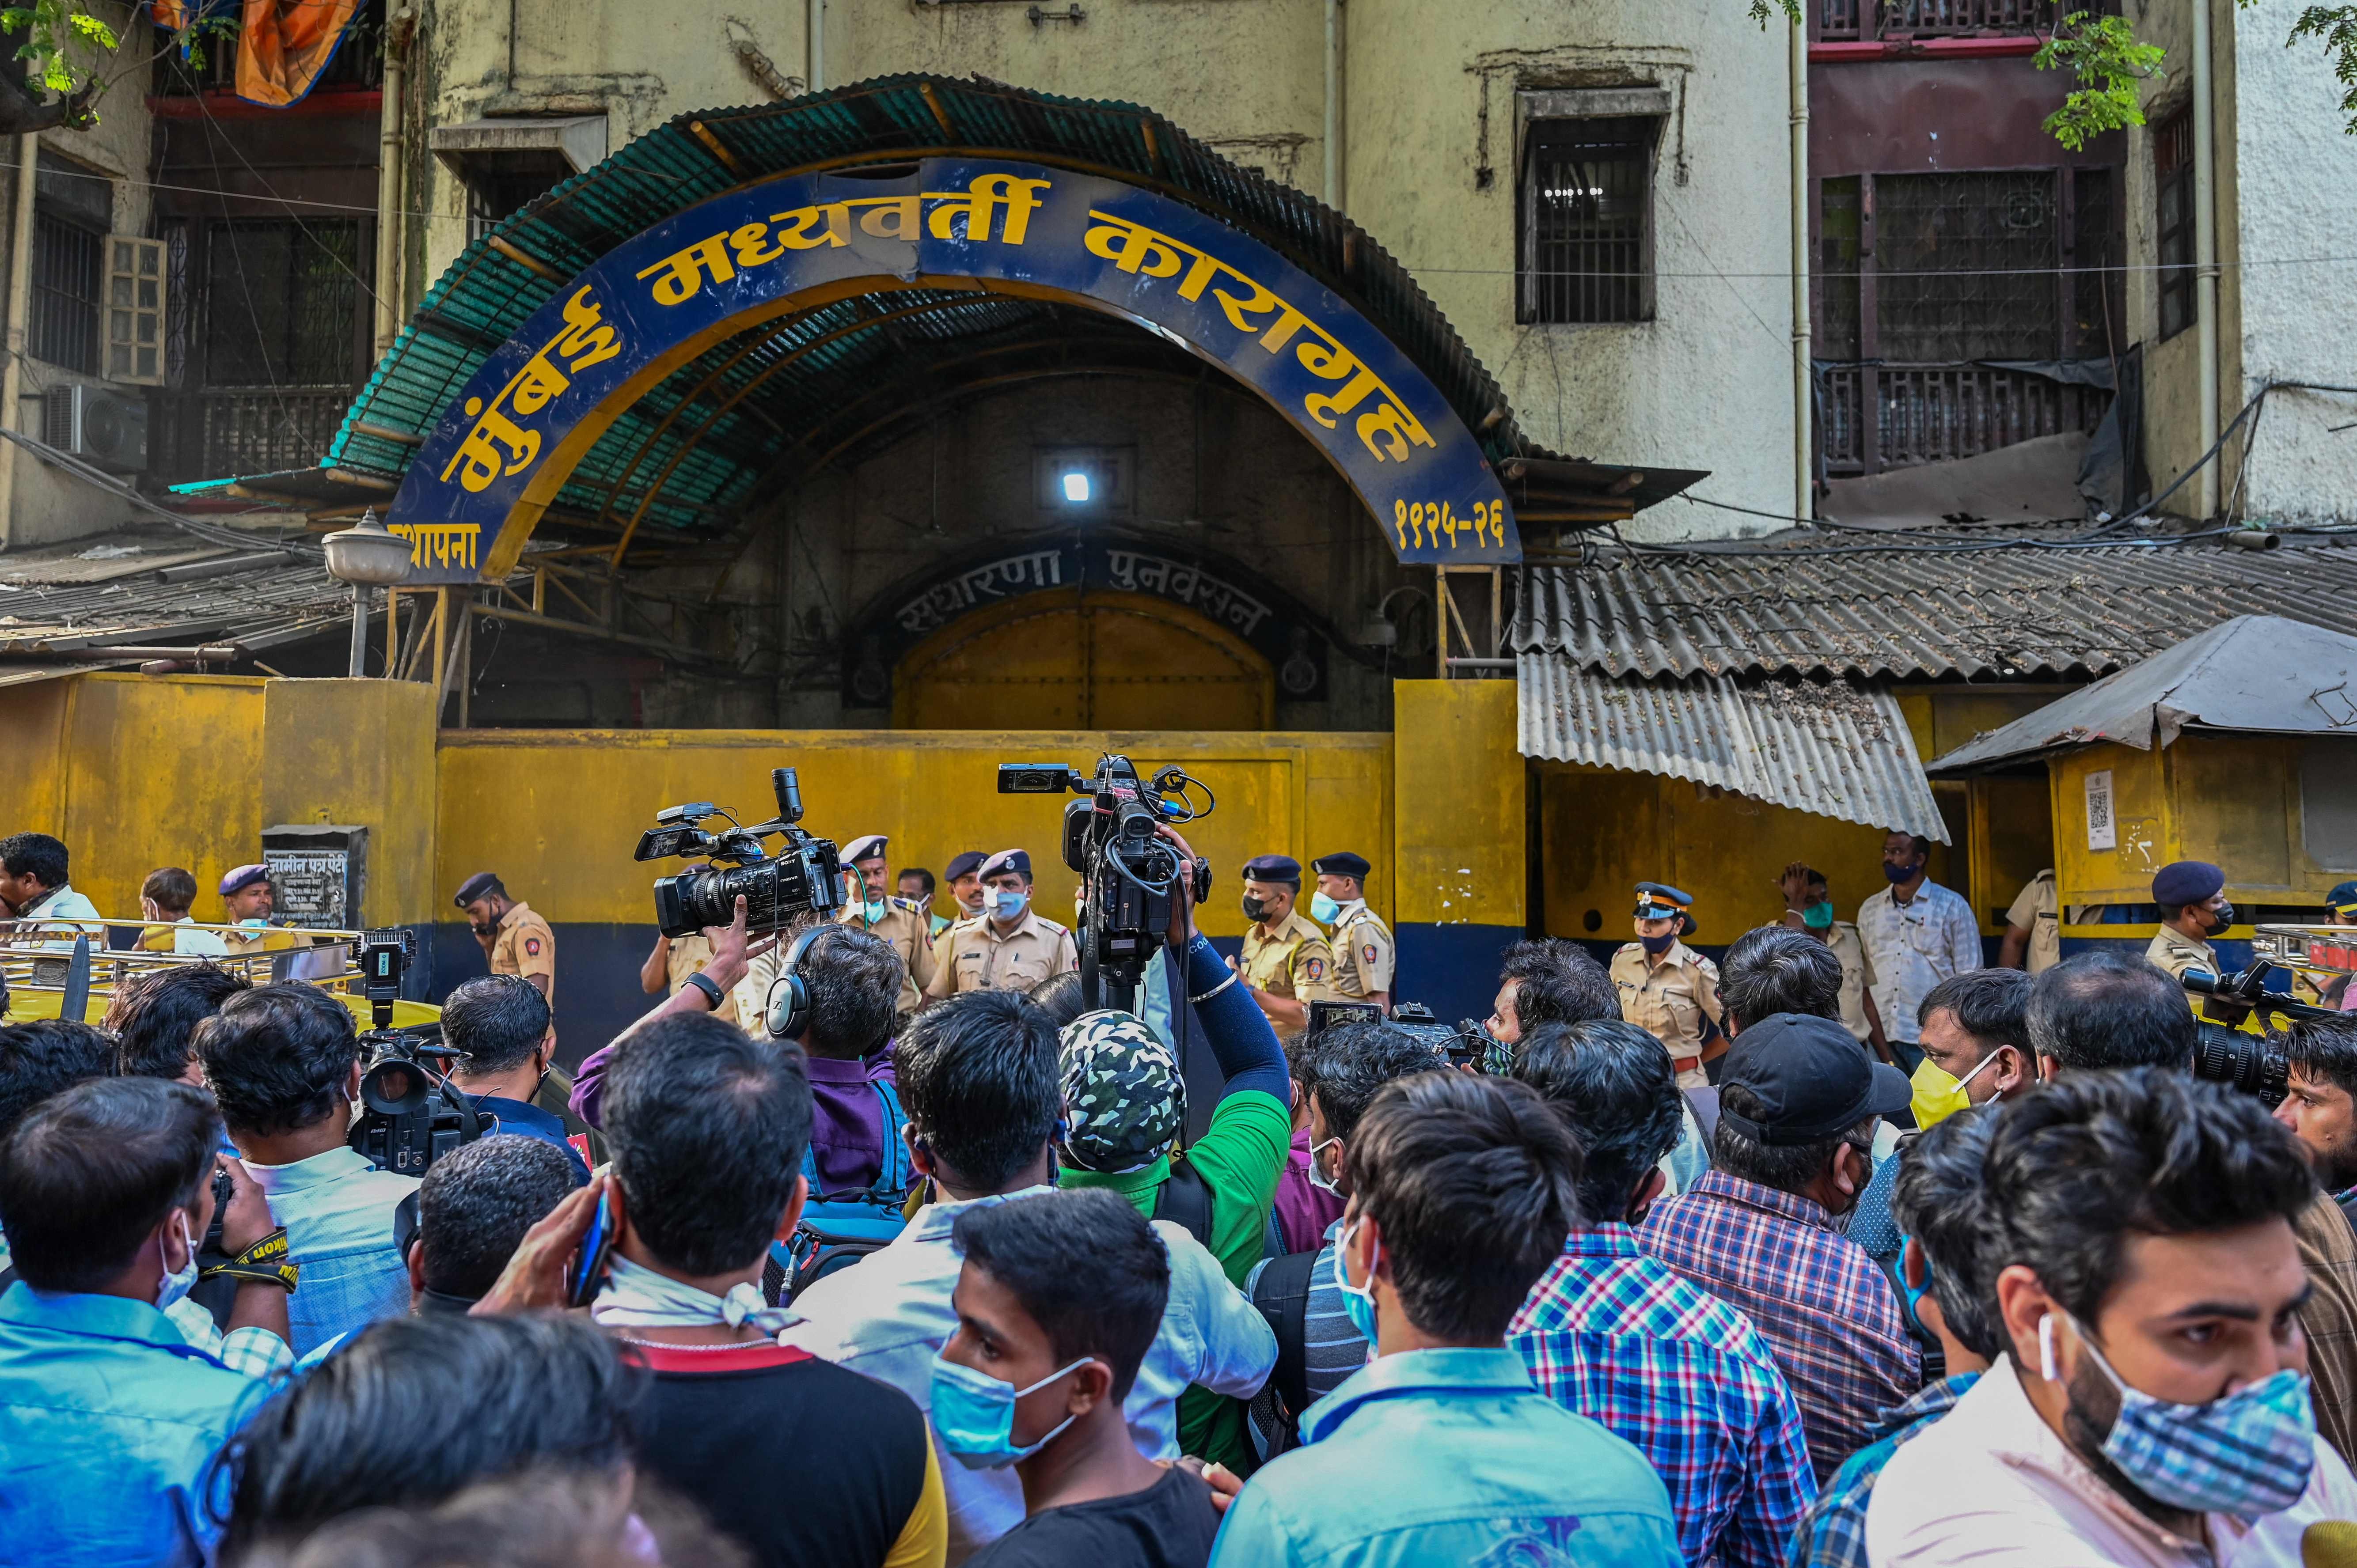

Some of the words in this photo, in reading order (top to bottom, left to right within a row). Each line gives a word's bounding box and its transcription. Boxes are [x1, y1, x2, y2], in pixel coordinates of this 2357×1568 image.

[440, 284, 621, 492] मुंबई
[637, 174, 1051, 306] मध्यवर्ती
[1084, 209, 1436, 463] कारागृह
[268, 854, 308, 874] जामीन
[308, 858, 327, 873] पत्र
[253, 1235, 288, 1259] Nikon
